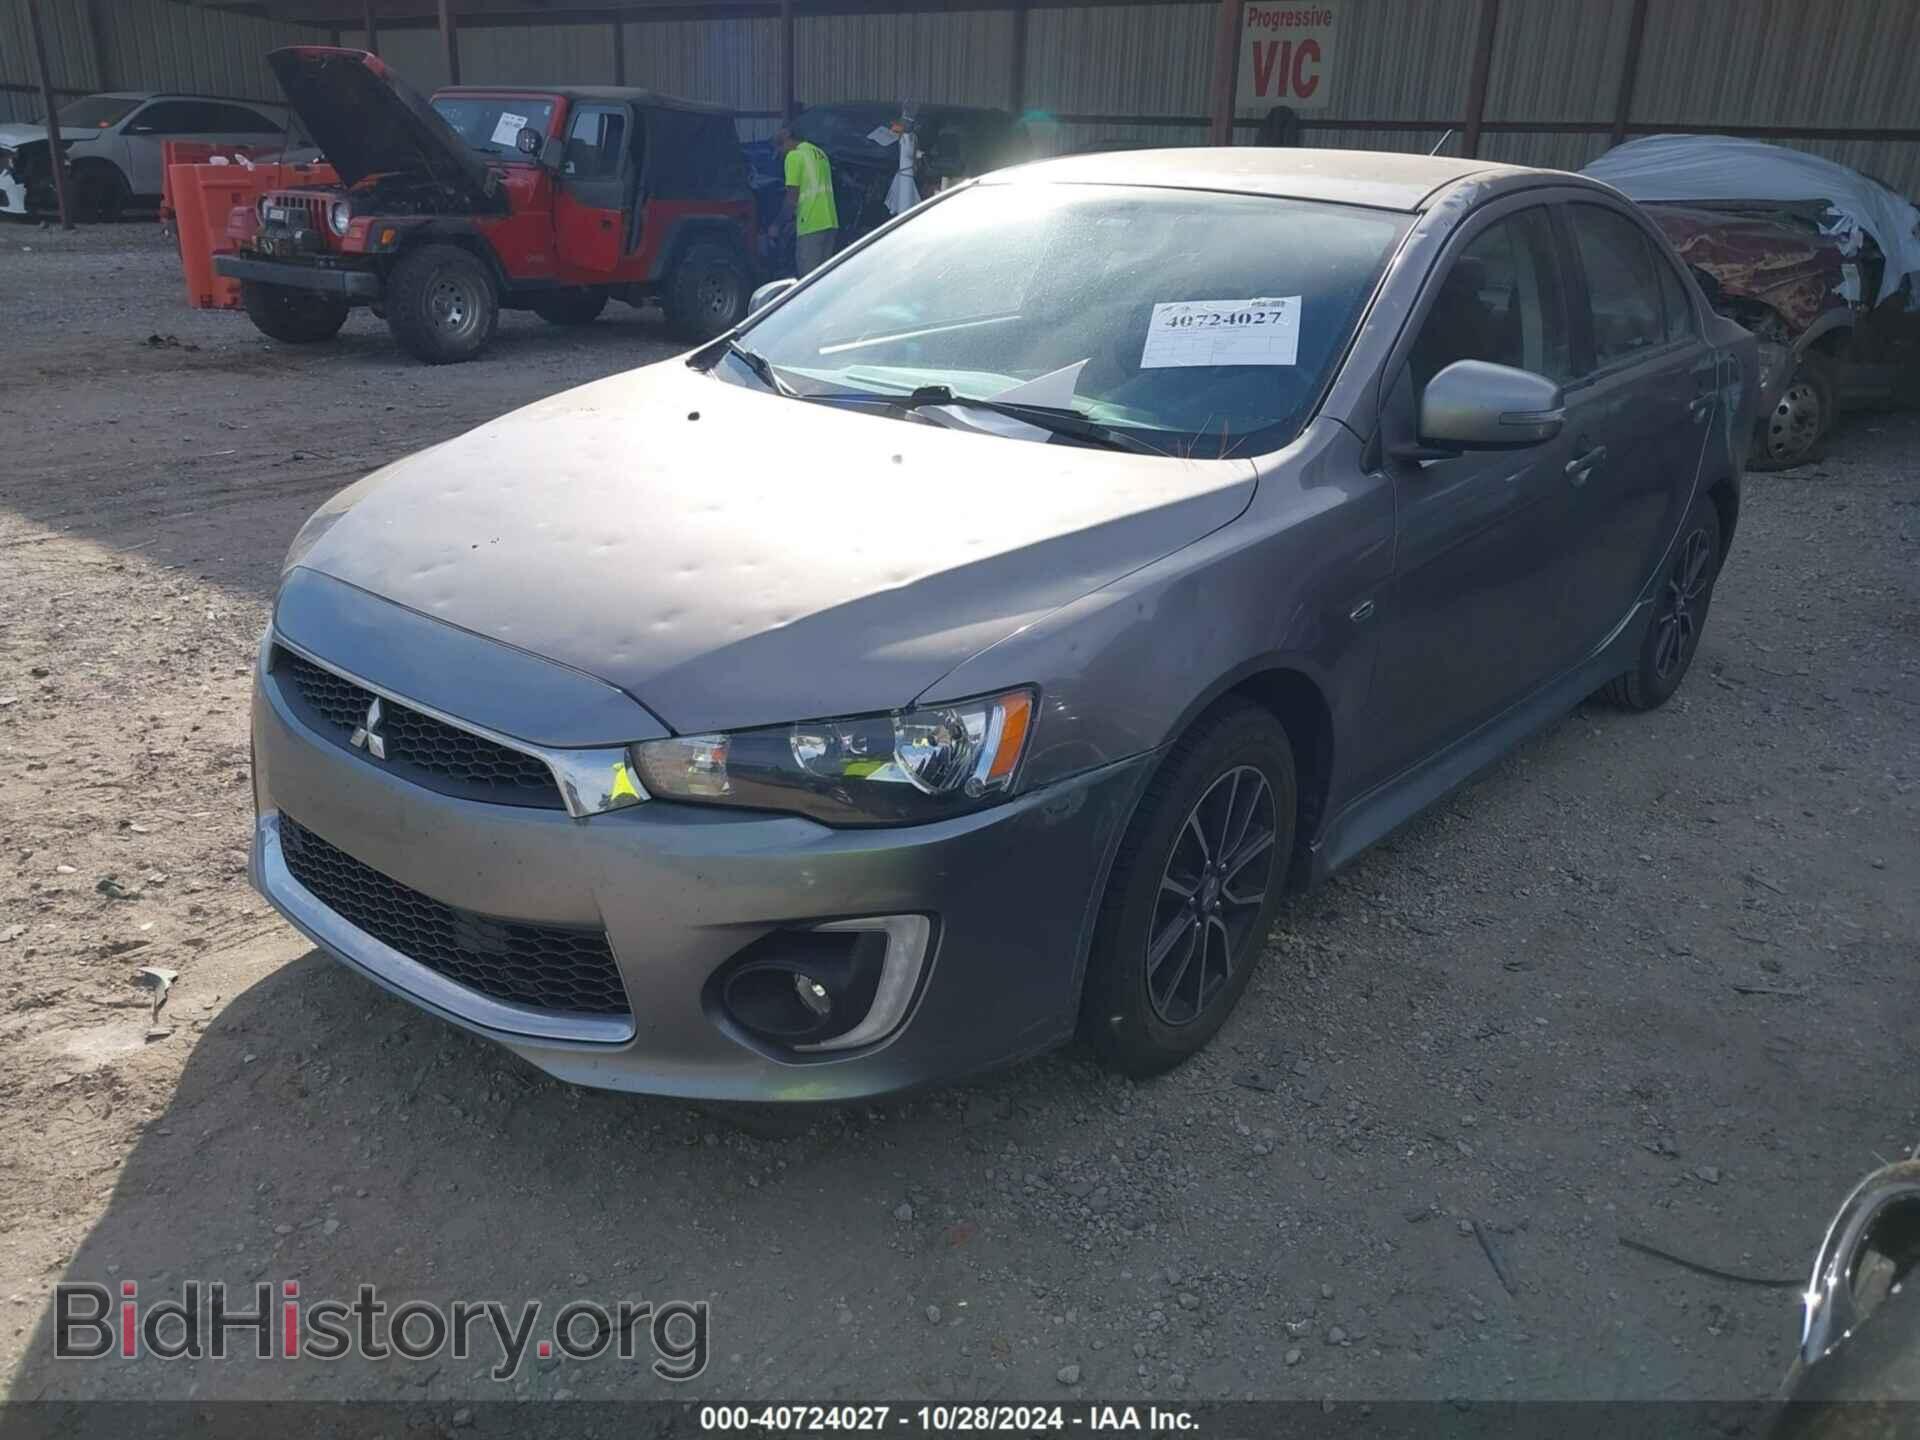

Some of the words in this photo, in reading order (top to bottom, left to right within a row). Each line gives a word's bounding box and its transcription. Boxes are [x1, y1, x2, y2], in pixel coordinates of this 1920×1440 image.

[1247, 4, 1332, 32] Progressive
[1252, 38, 1321, 98] VIC
[1164, 311, 1282, 328] 40724027
